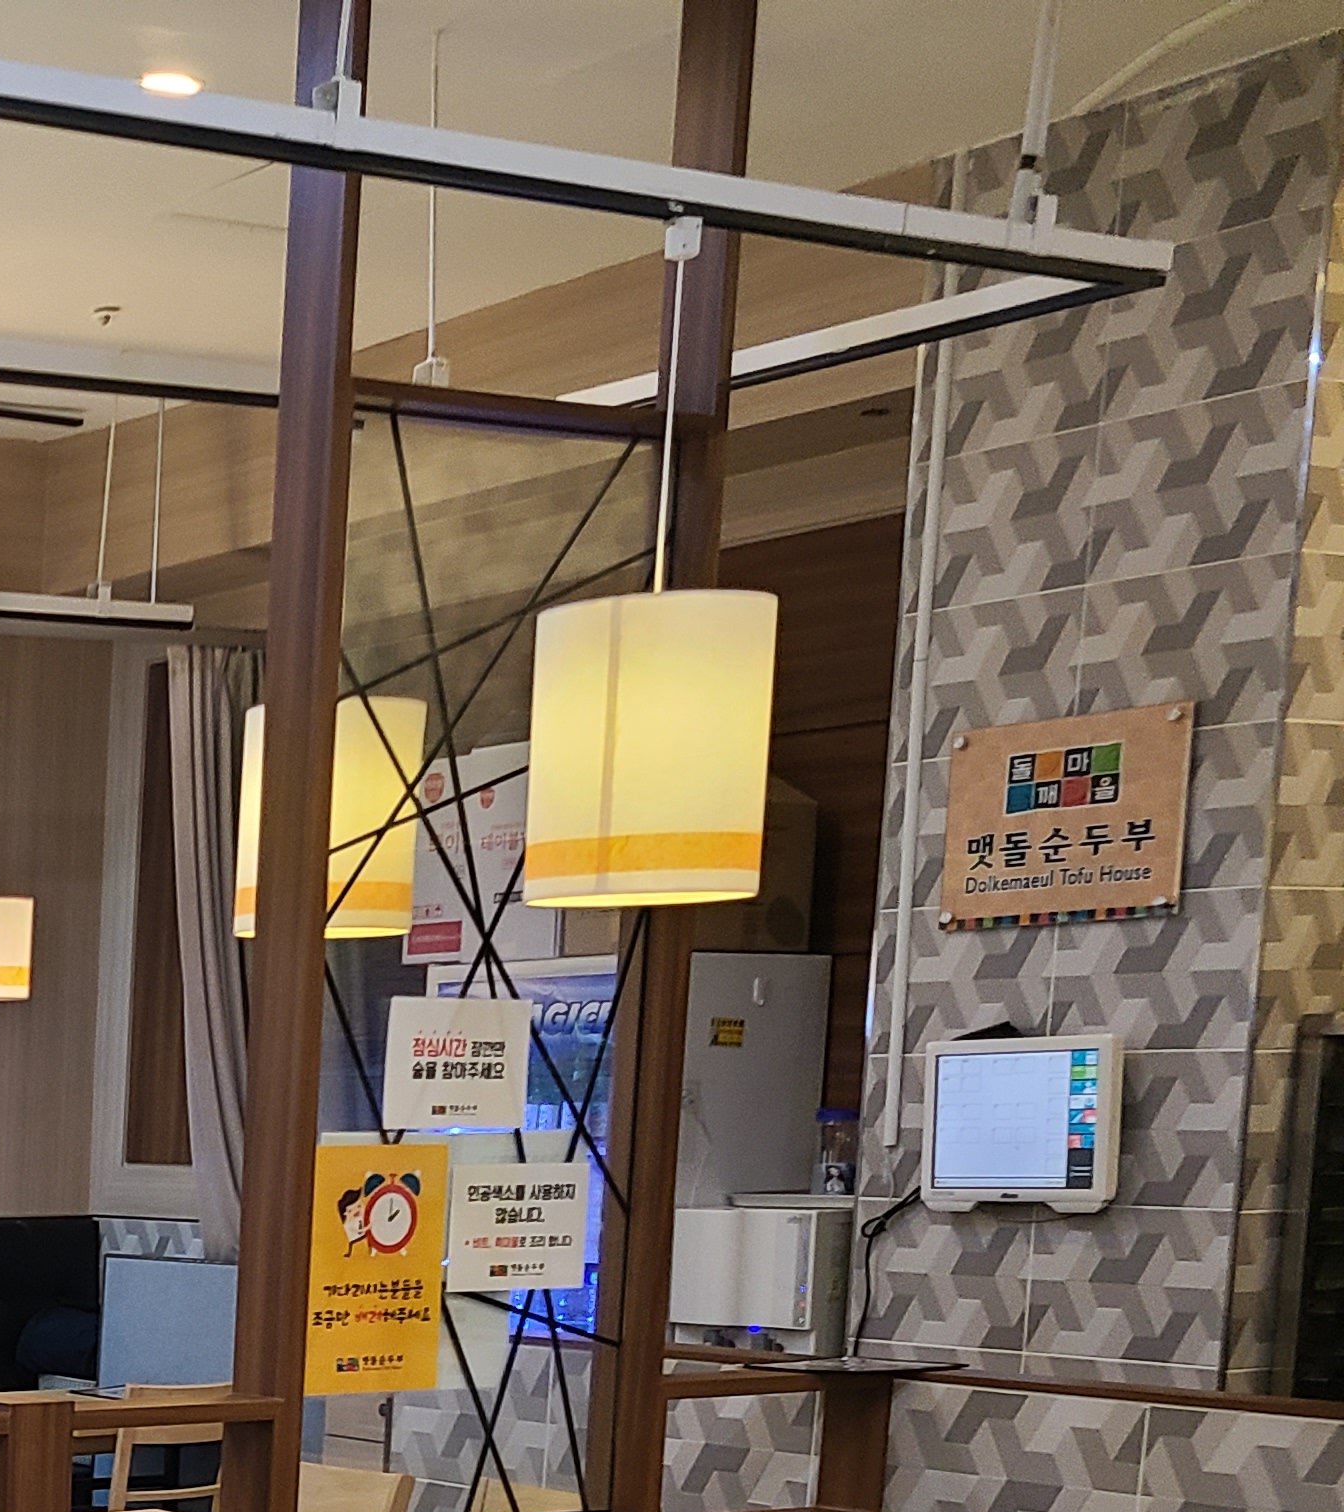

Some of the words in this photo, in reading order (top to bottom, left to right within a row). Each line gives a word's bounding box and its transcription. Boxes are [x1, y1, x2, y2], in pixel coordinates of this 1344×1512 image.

[967, 819, 1156, 871] 맷돌순두부
[965, 870, 1054, 894] Dolkemaeul
[1059, 867, 1094, 885] Tofu
[1100, 865, 1153, 883] House
[413, 1038, 467, 1057] 점심시간
[413, 1061, 437, 1079] 술을
[442, 1061, 505, 1080] 참아주세요
[468, 1185, 525, 1202] 인공색소를
[529, 1183, 576, 1201] 사용하지
[495, 1207, 545, 1224] 않습니다.
[312, 1310, 351, 1329] 조금만
